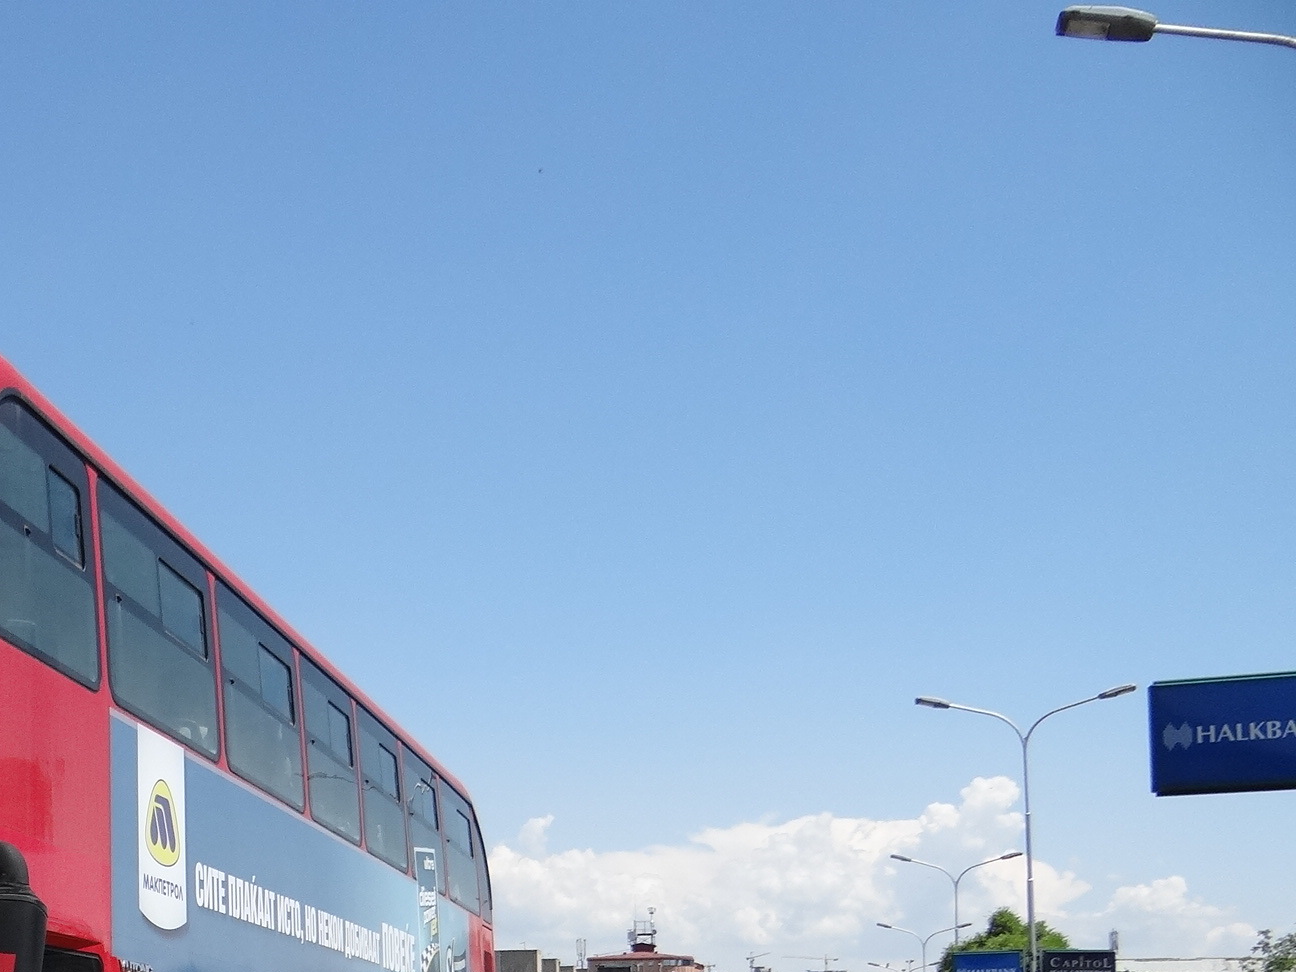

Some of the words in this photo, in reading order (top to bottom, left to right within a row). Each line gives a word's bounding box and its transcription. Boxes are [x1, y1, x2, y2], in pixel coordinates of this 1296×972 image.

[142, 873, 184, 901] МАКПЕТРОЛ
[195, 862, 226, 914] СИТЕ
[276, 894, 304, 944] ИСТО,
[305, 904, 317, 944] НО
